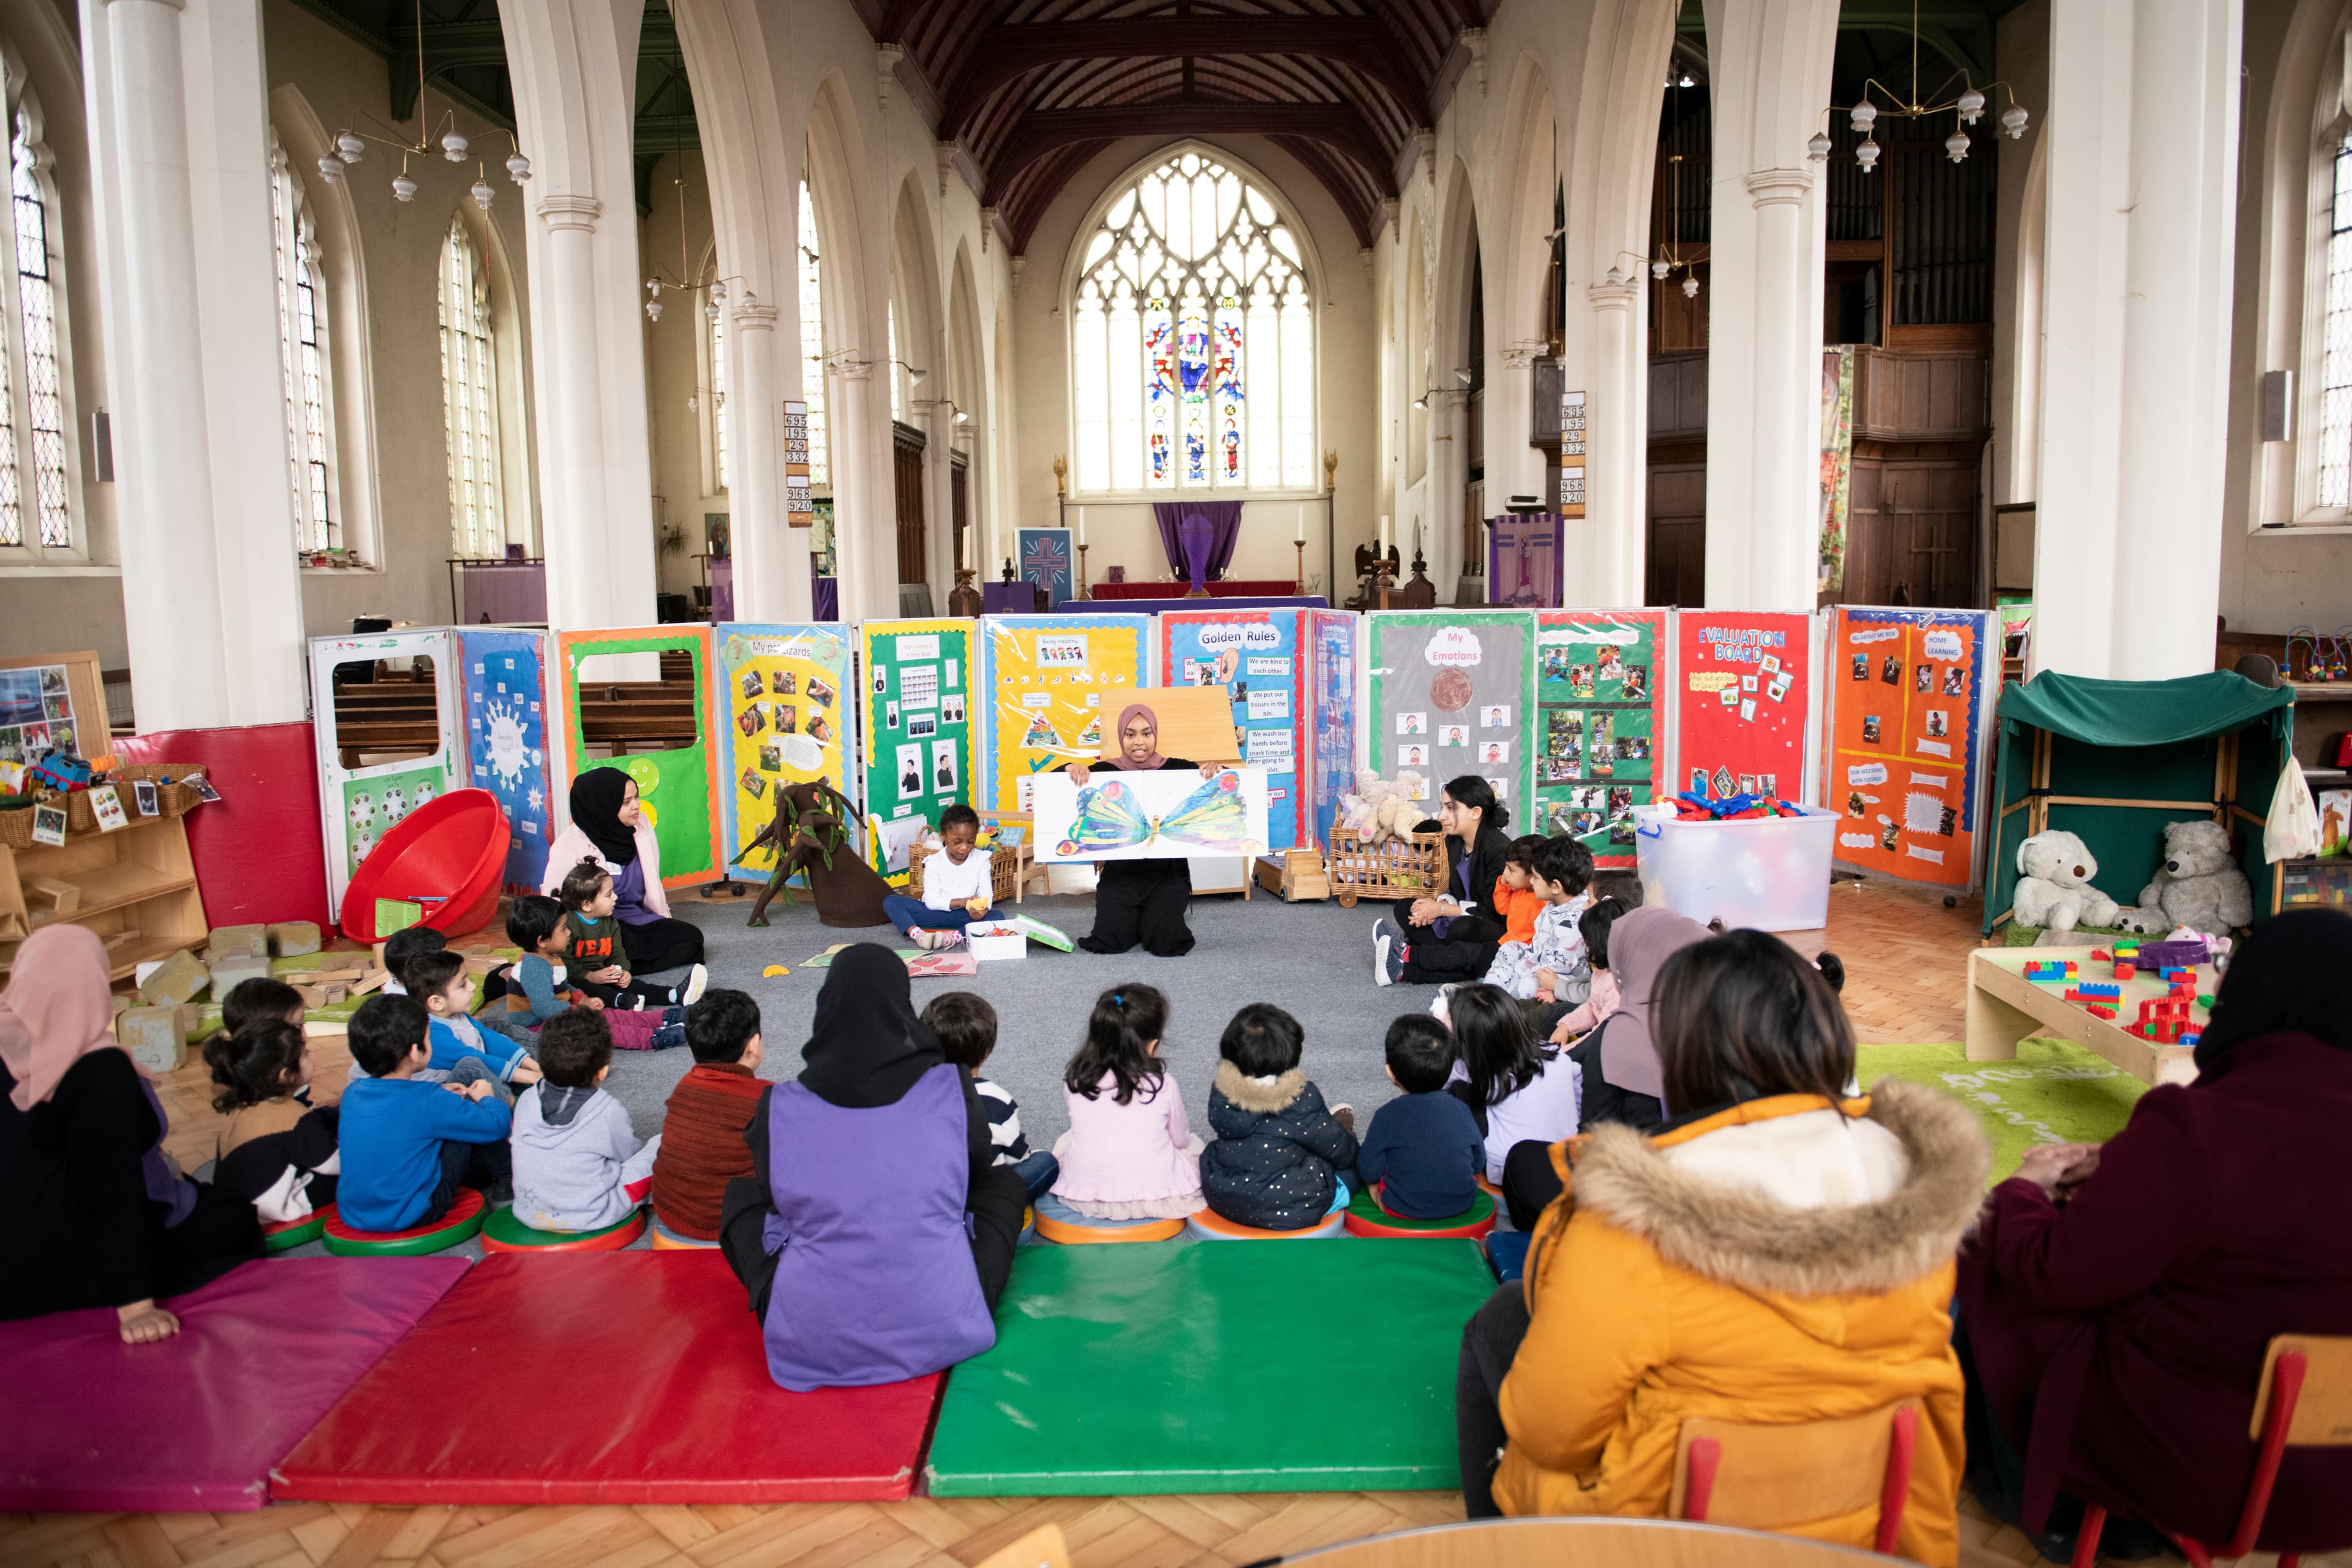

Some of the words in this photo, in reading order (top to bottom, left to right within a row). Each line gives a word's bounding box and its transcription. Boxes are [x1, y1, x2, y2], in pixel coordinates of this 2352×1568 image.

[1564, 407, 1584, 417] 695
[786, 416, 807, 426] 695
[1564, 419, 1583, 429] 195
[787, 429, 807, 439] 195
[1566, 431, 1580, 442] 29
[790, 441, 804, 451] 29
[1564, 443, 1584, 454] 332
[788, 453, 809, 462] 332
[1562, 480, 1583, 491] 968
[788, 489, 810, 499] 968
[1562, 492, 1582, 503] 920
[789, 501, 811, 511] 920
[1202, 631, 1241, 644] Golden
[1247, 630, 1275, 641] Rules
[1448, 633, 1463, 643] My
[1698, 627, 1785, 647] EVALUATION
[753, 642, 766, 653] My
[1433, 652, 1477, 660] Emotions
[1715, 644, 1762, 663] BOARD
